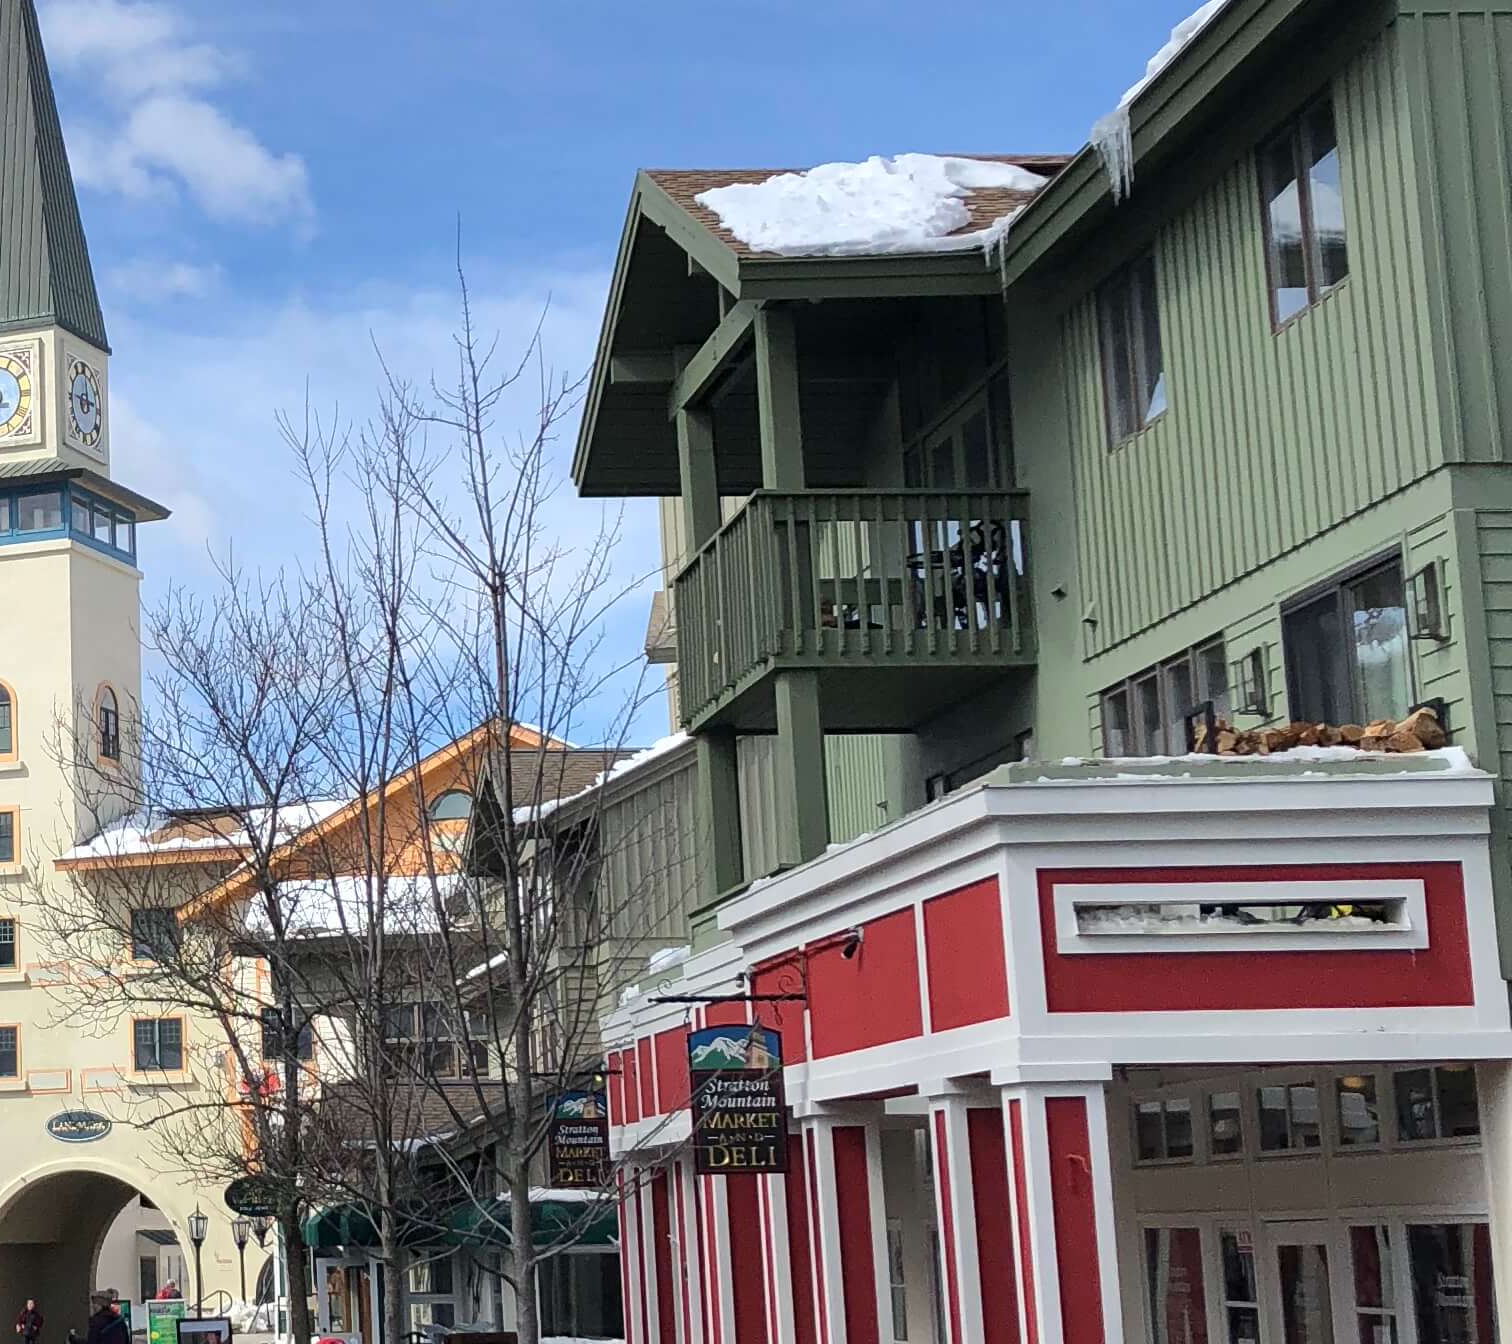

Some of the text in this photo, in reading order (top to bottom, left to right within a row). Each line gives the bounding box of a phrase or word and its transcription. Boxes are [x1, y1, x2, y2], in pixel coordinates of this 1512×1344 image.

[705, 1078, 770, 1094] Stratton
[700, 1093, 776, 1109] Mountain
[703, 1112, 777, 1129] MARKET
[708, 1145, 777, 1167] DELI
